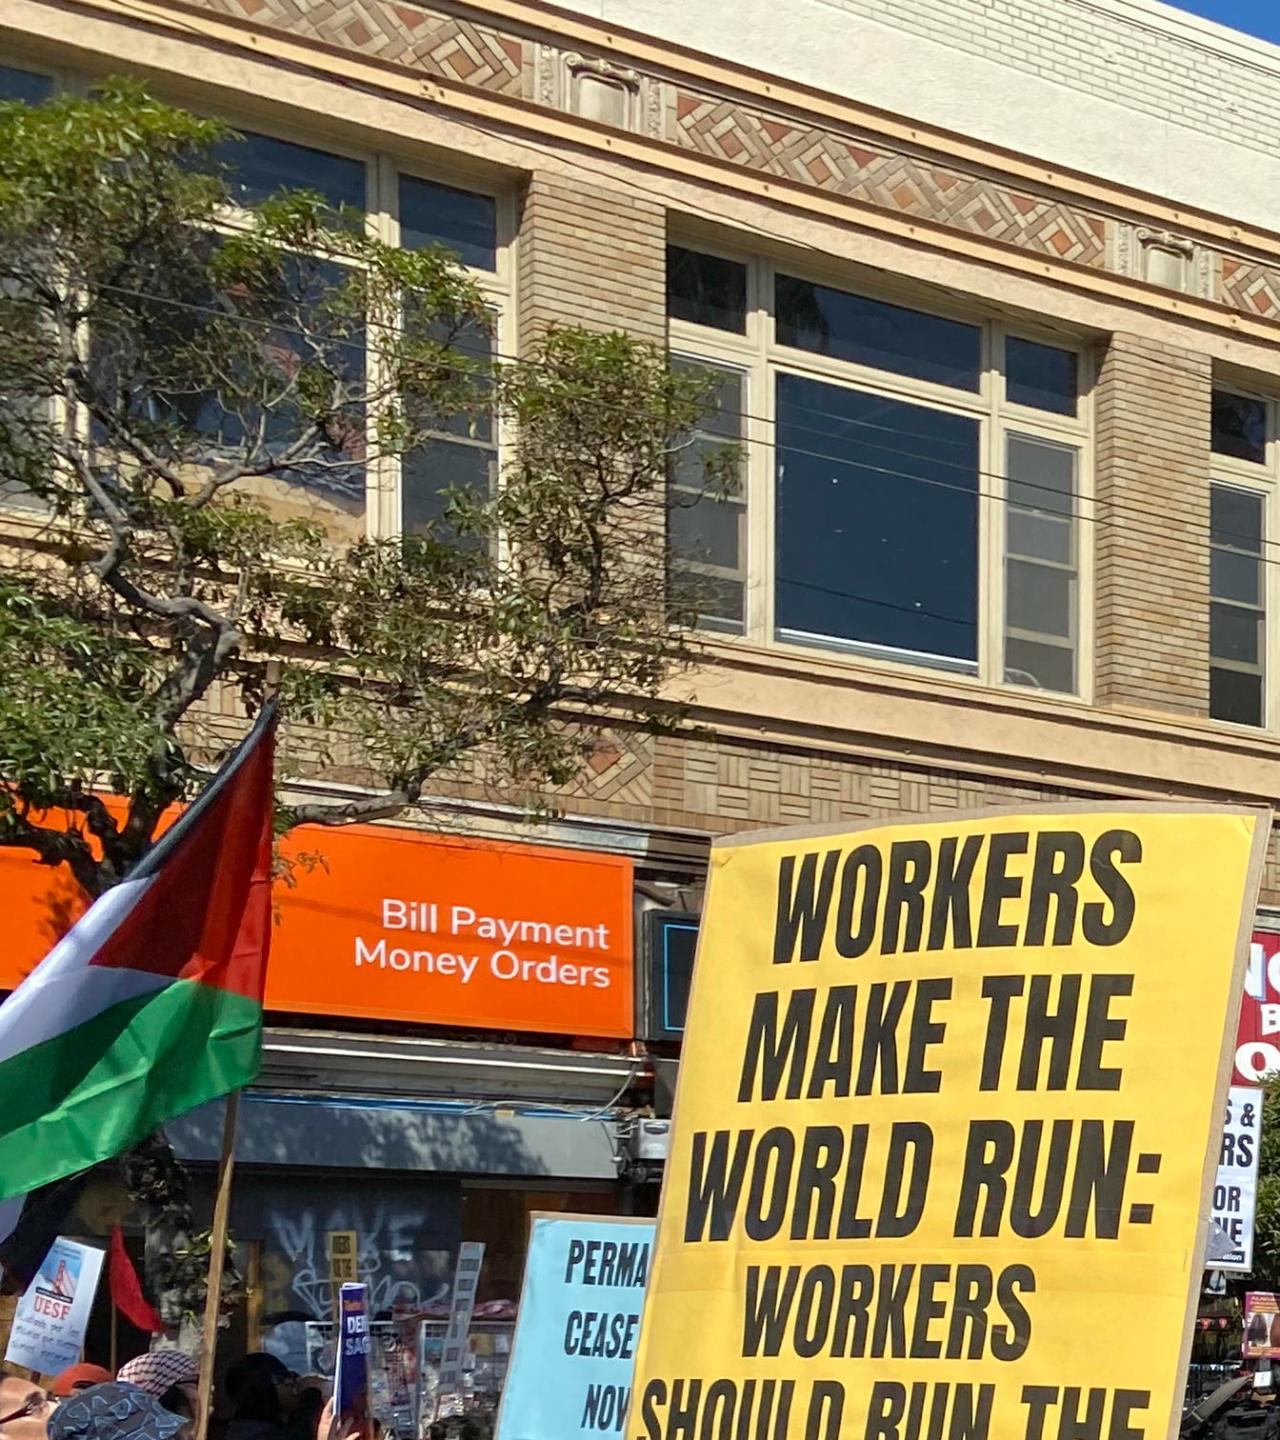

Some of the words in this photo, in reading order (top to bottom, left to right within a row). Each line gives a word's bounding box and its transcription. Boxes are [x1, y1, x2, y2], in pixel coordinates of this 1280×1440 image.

[773, 829, 1142, 965] WORKERS
[382, 898, 438, 934] Bill
[451, 906, 610, 951] Payment
[354, 936, 479, 984] Money
[490, 950, 611, 989] Orders
[737, 978, 953, 1103] MAKE
[979, 972, 1135, 1092] THE
[1240, 1103, 1255, 1127] &
[684, 1121, 934, 1243] WORLD
[953, 1119, 1162, 1240] RUN:
[1213, 1185, 1241, 1213] OR
[564, 1311, 639, 1359] CEASE
[741, 1264, 1036, 1362] WORKERS
